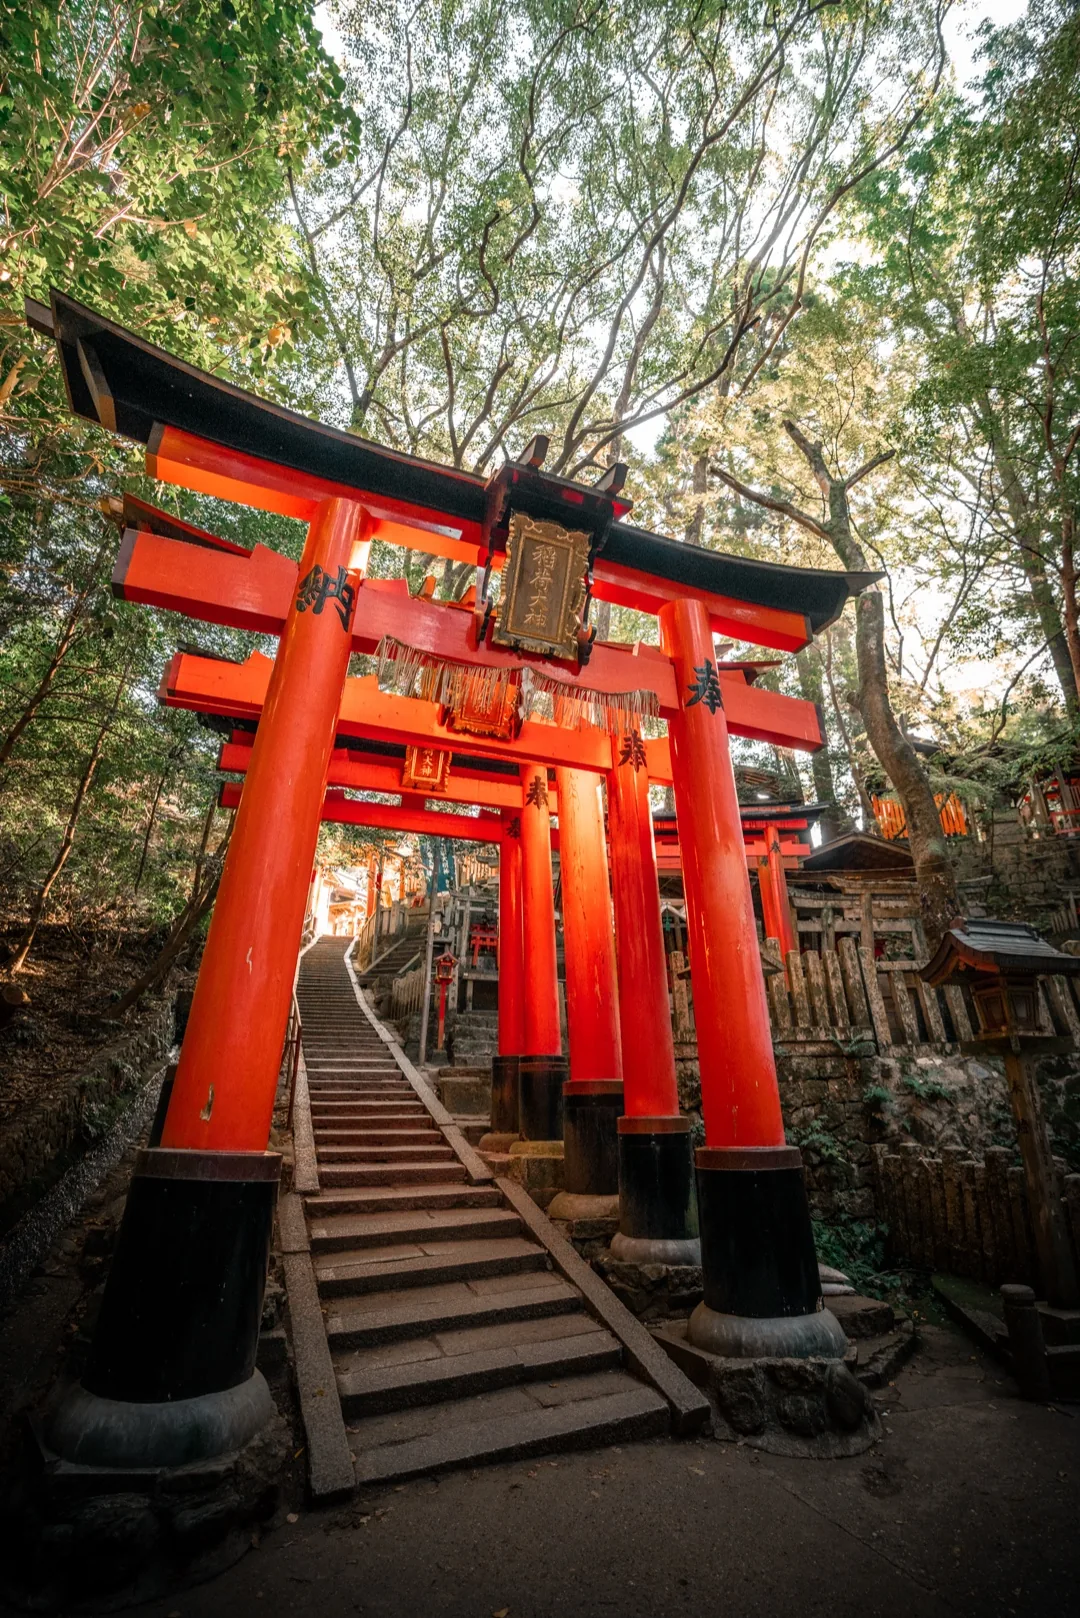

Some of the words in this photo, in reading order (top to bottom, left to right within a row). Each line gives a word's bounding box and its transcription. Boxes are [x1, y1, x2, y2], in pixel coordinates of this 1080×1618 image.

[686, 658, 724, 715] 奉
[618, 730, 647, 773] 奉
[525, 775, 548, 810] 奉
